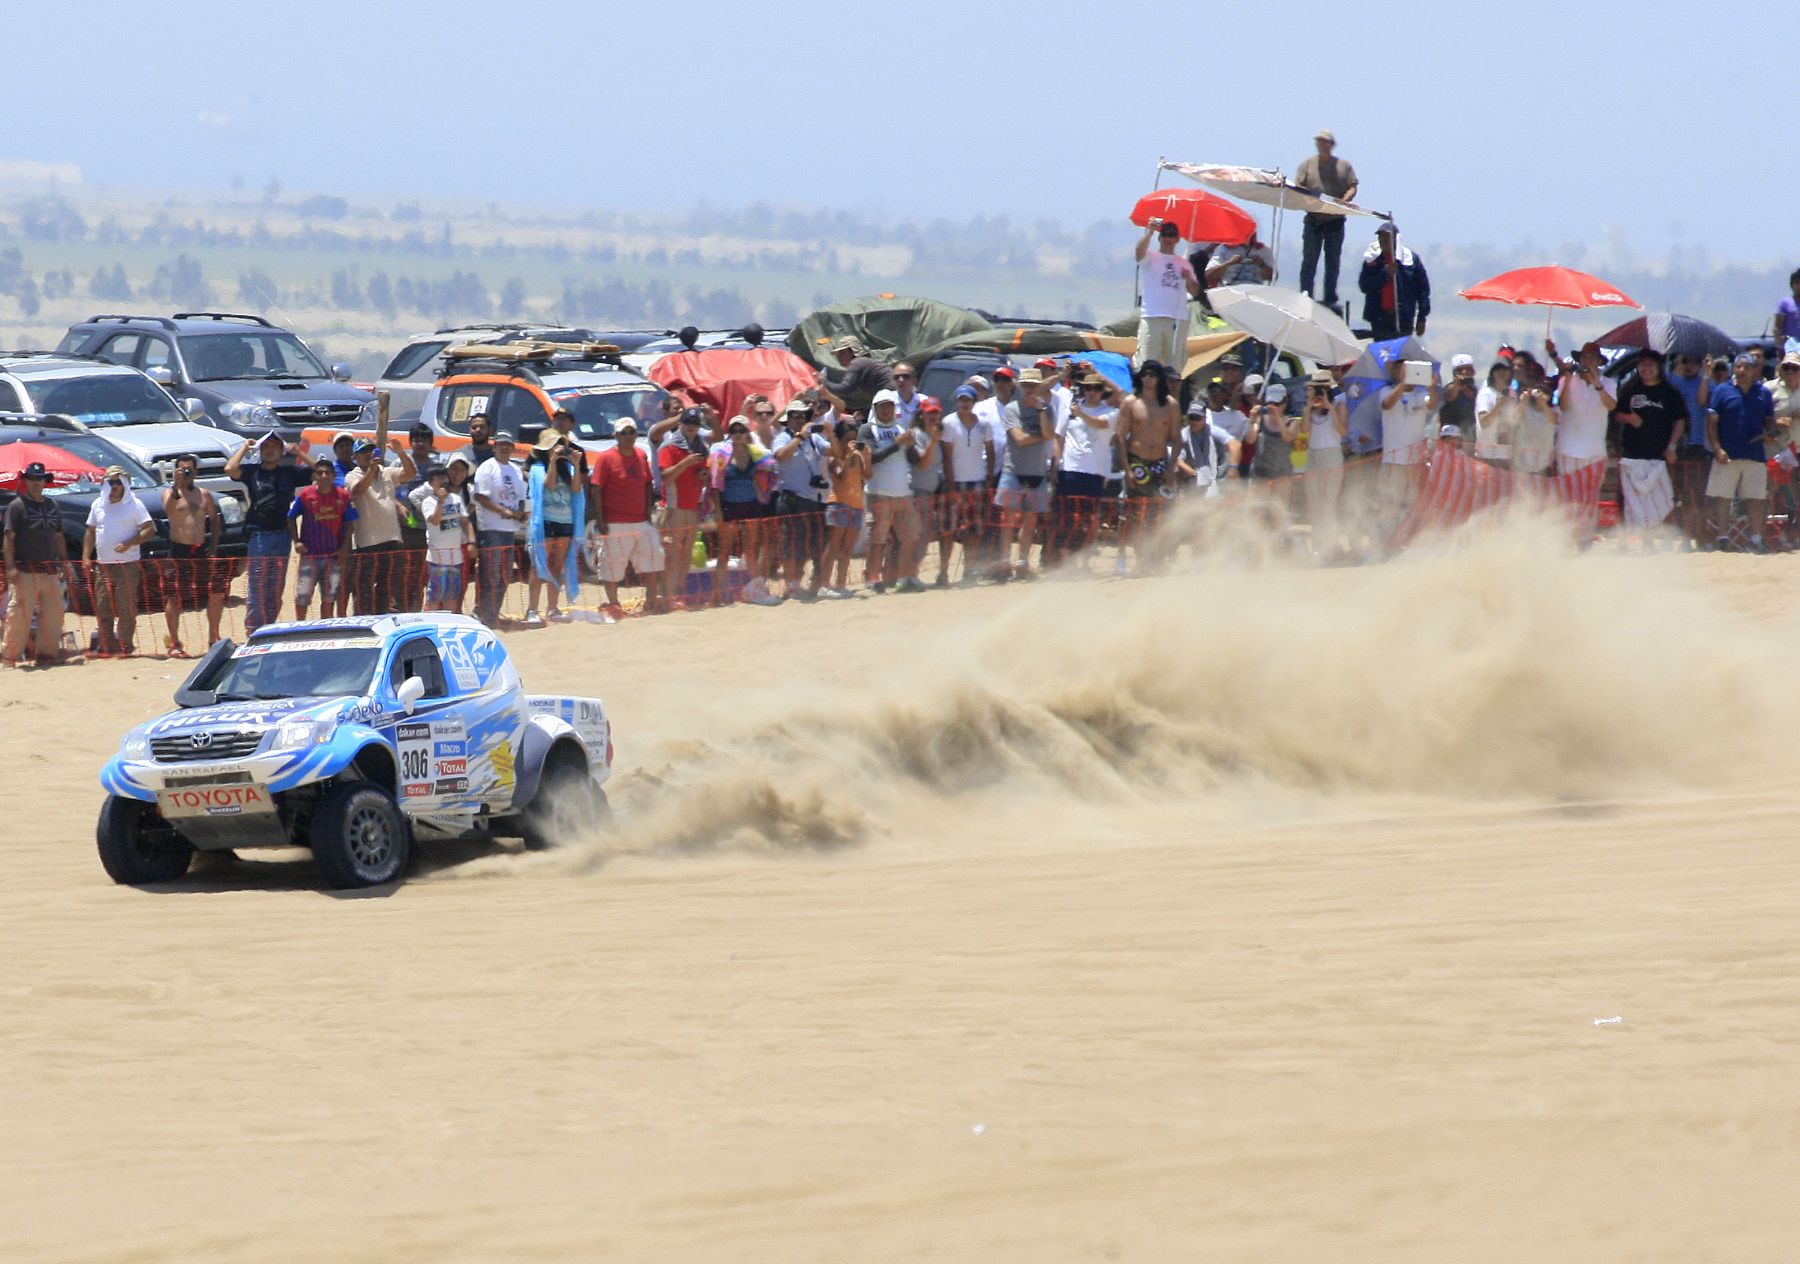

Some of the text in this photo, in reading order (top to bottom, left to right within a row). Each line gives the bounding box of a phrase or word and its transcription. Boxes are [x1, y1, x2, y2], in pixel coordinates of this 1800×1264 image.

[281, 641, 337, 650] TOYOTA
[160, 712, 270, 732] HILUX
[440, 744, 460, 753] Macro
[402, 748, 429, 780] 306
[441, 762, 466, 773] TOTAL
[407, 786, 426, 795] TOTAL
[168, 786, 262, 808] TOYOTA
